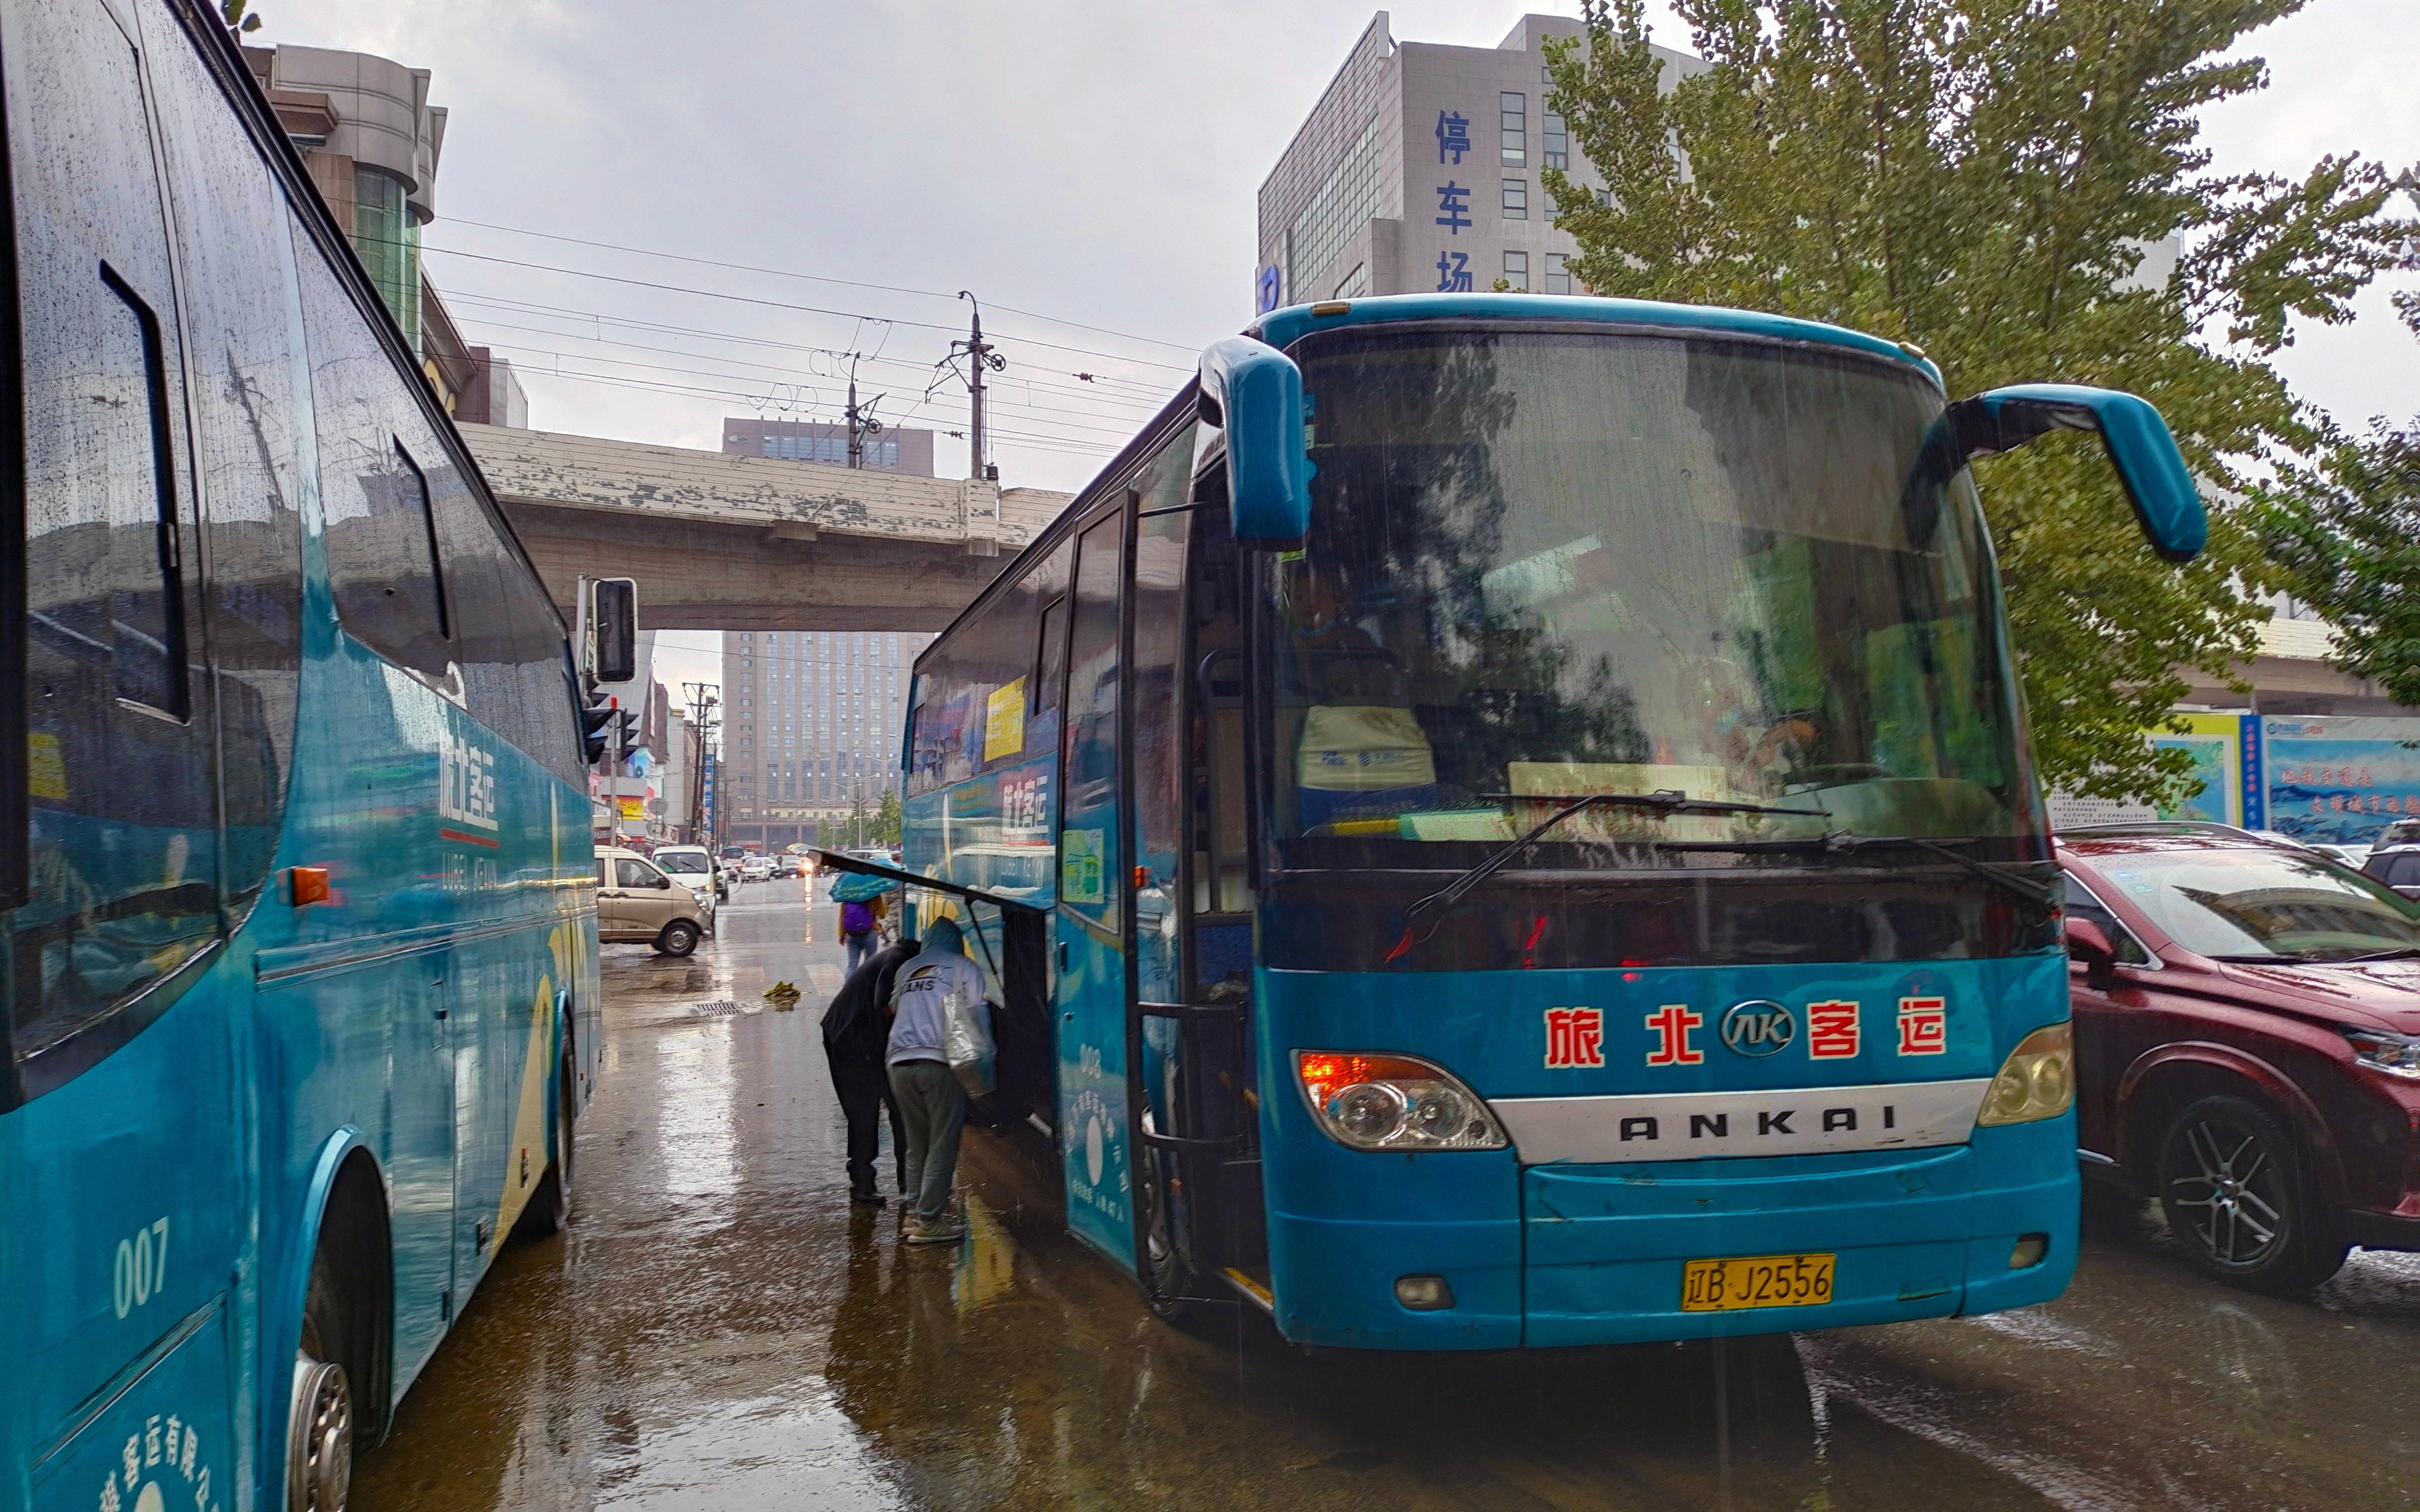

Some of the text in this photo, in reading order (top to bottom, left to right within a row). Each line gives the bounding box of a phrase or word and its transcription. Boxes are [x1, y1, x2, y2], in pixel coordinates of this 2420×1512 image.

[1435, 109, 1472, 293] 停车场
[2281, 766, 2374, 788] 地铁交通是
[1619, 1105, 1895, 1142] ANKAI
[114, 1215, 169, 1320] 007
